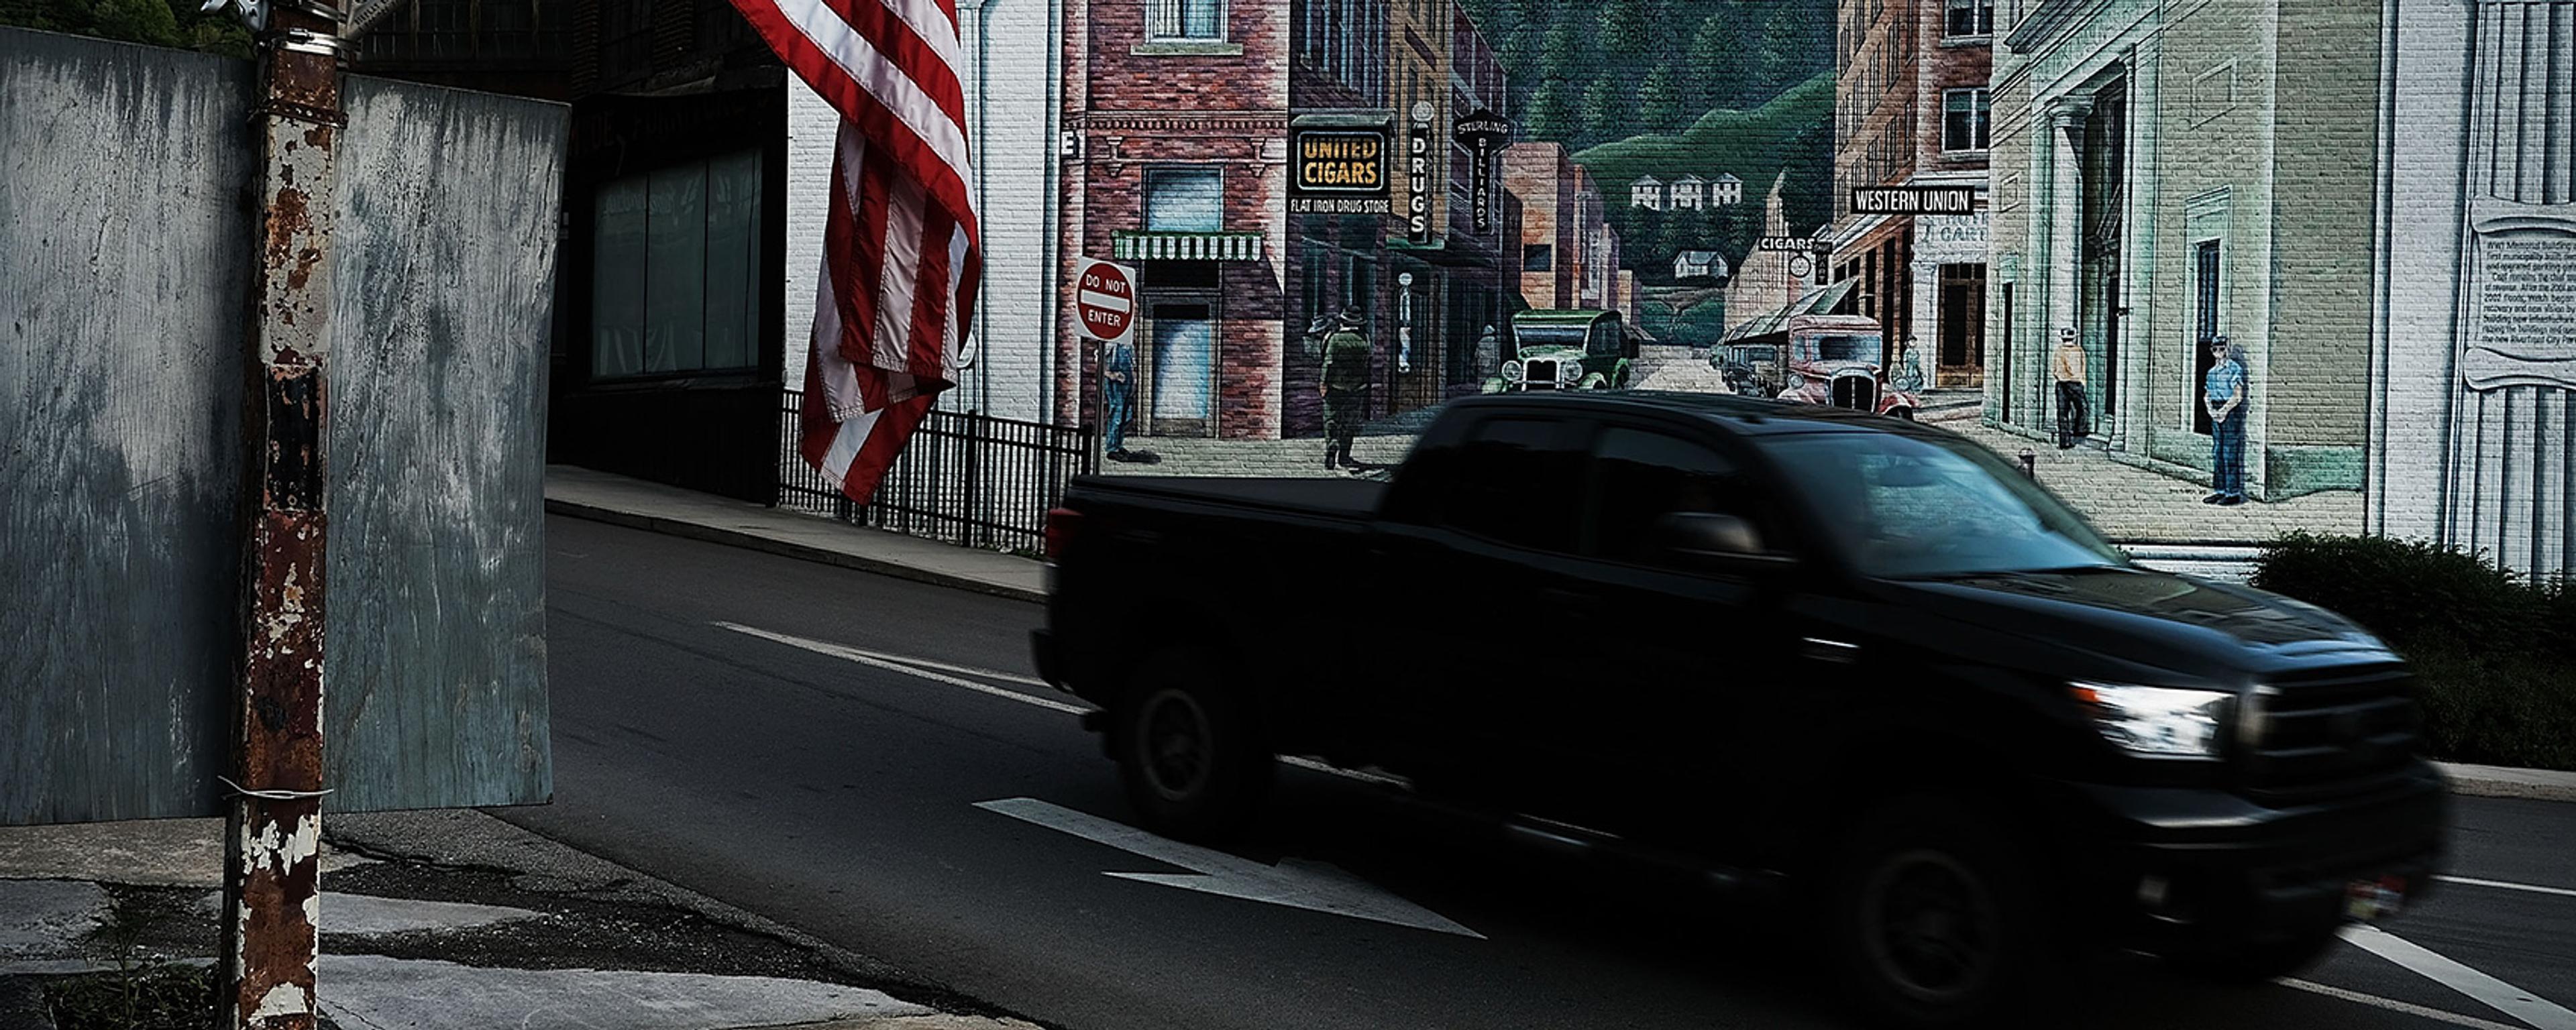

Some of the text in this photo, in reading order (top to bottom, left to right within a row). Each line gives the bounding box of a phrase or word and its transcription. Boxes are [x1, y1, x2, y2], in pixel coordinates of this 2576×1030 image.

[1458, 121, 1509, 134] STERLING
[1304, 138, 1377, 159] UNITED
[1304, 162, 1377, 184] CIGARS
[1477, 137, 1487, 228] BILLIARDS
[1411, 137, 1426, 233] DRUGS
[1291, 199, 1389, 214] FLAT IRON DRUG STORE
[1856, 190, 1969, 212] WESTERN UNION
[1761, 237, 1815, 249] CIGARS
[1086, 274, 1126, 294] DO NOT
[1088, 309, 1120, 327] ENTER
